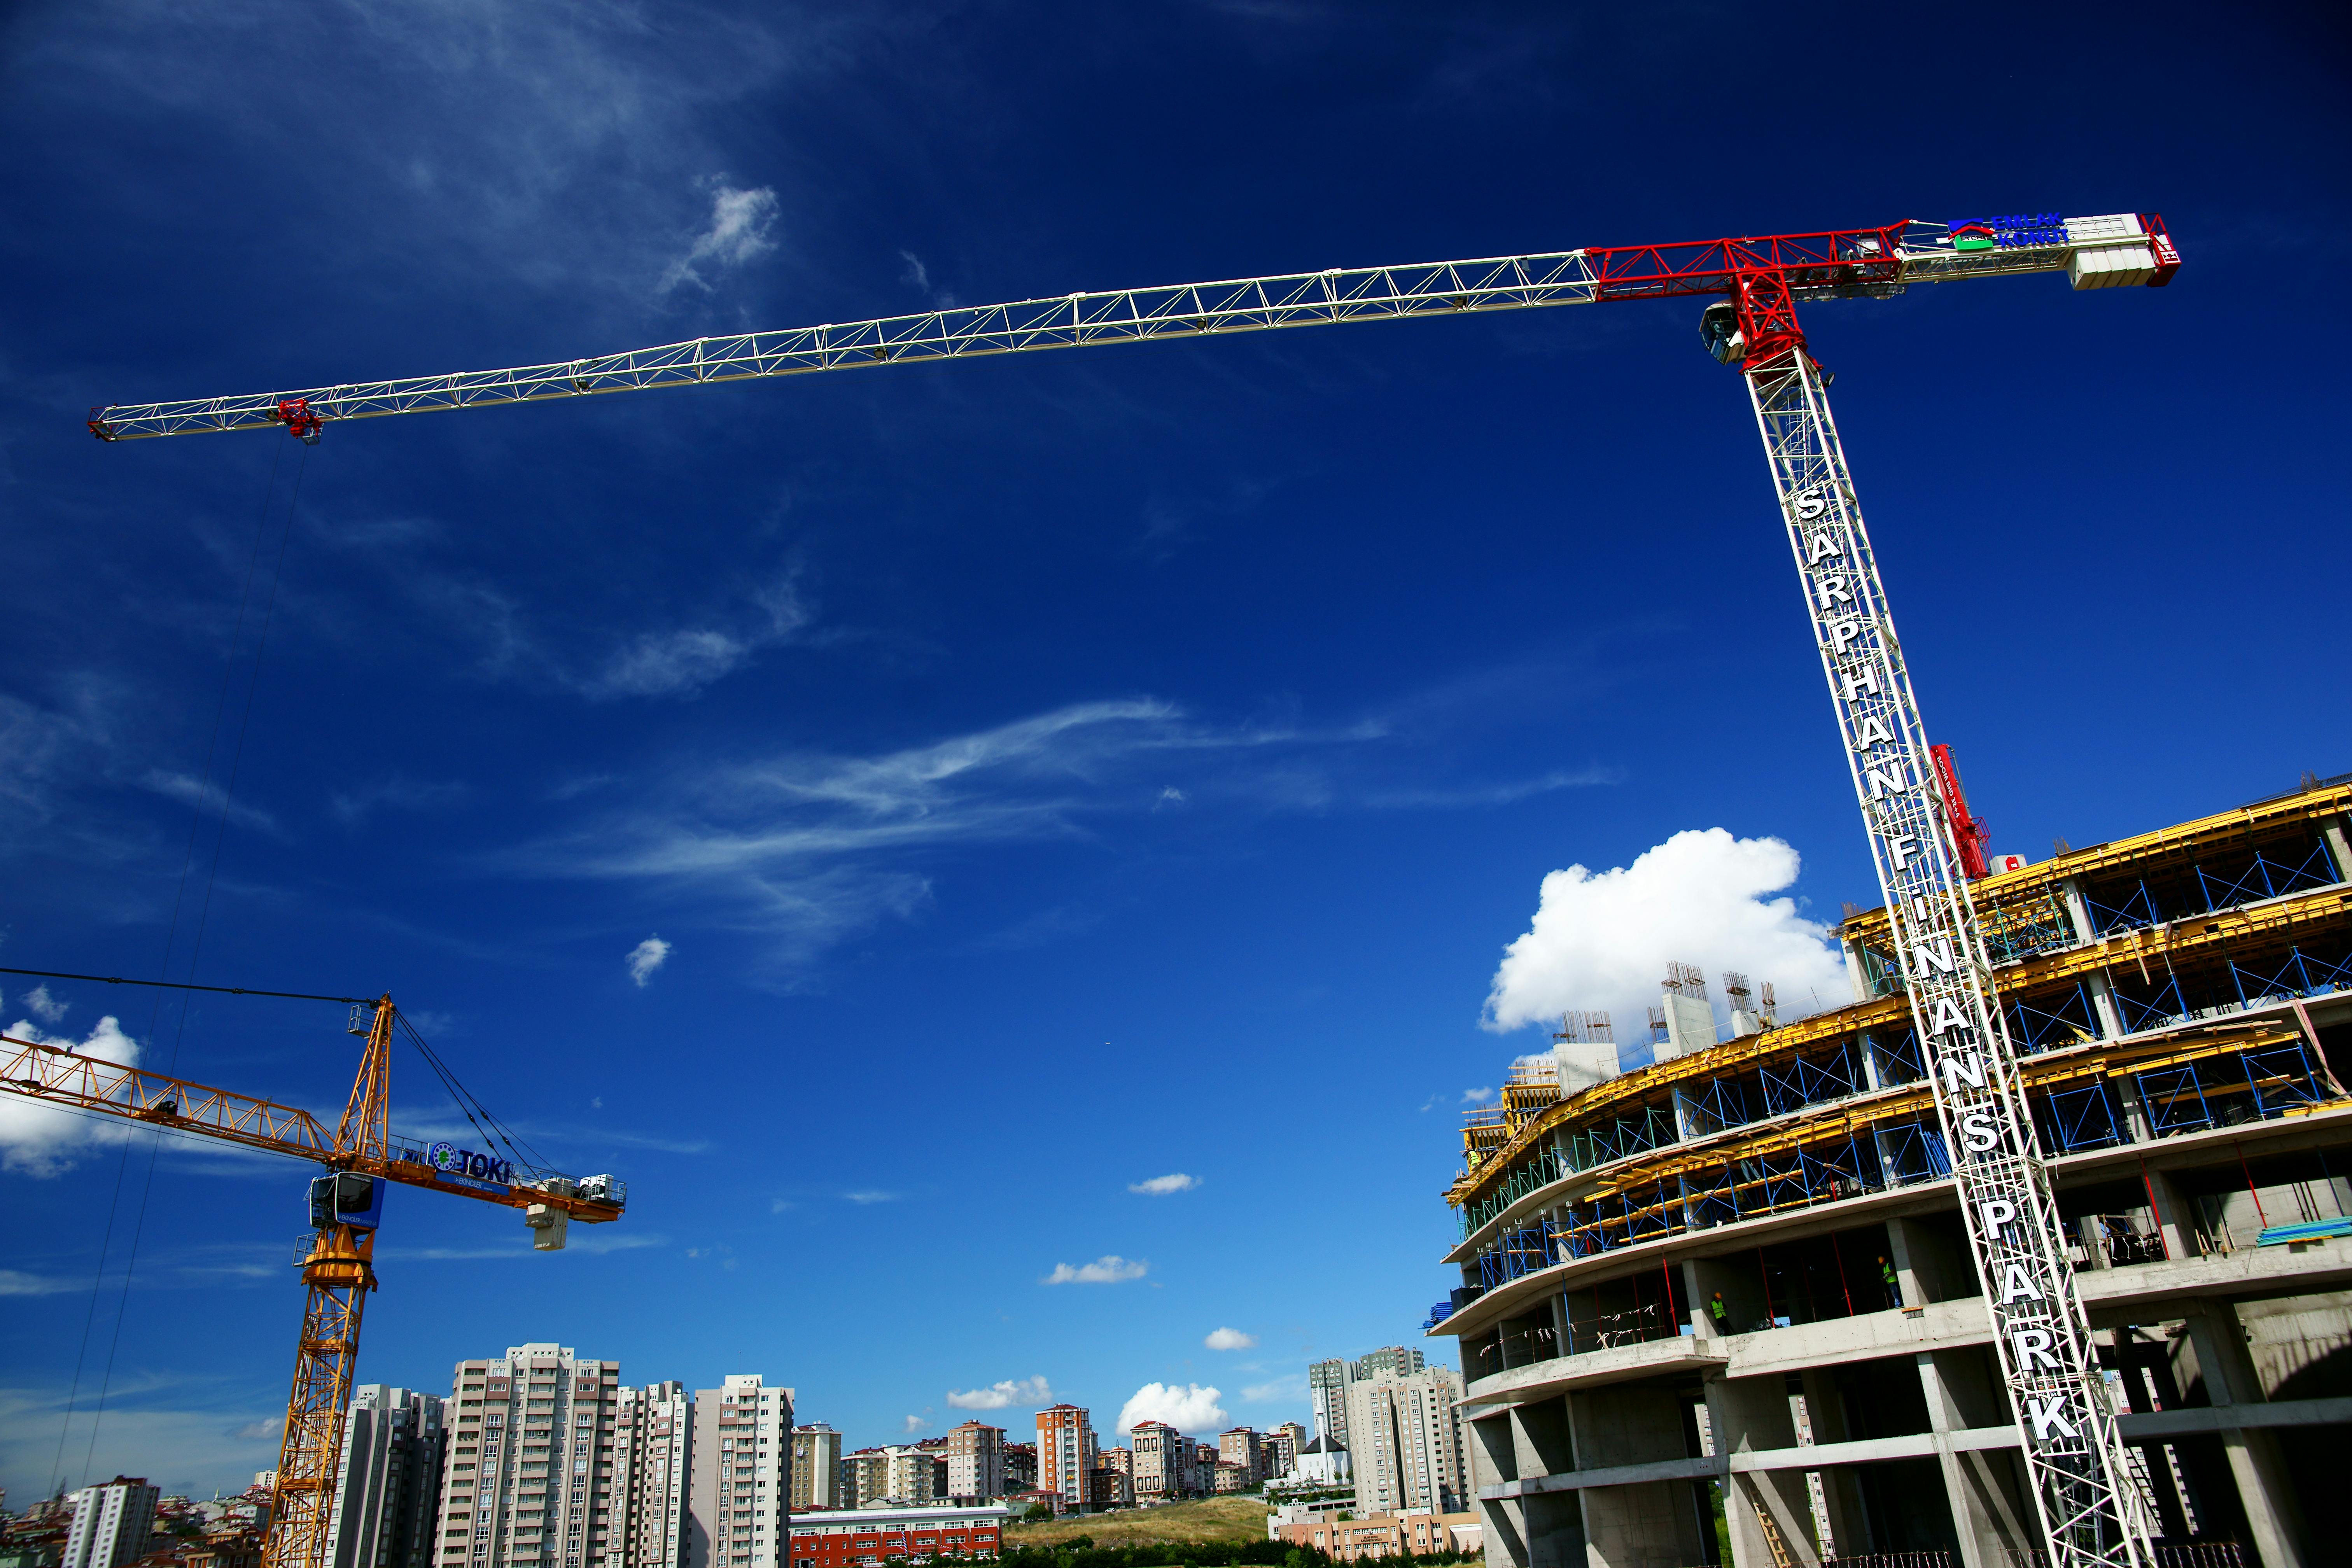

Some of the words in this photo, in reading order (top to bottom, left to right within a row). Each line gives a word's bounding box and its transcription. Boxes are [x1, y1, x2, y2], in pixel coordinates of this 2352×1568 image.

[1990, 212, 2065, 231] EMLAK
[1997, 229, 2070, 248] KONUT
[1937, 756, 1948, 781] BOOM
[1951, 796, 1960, 818] 32+4
[1796, 488, 1907, 802] SARPHAN
[1980, 1199, 2081, 1441] PARK
[458, 1149, 511, 1184] TOKİ
